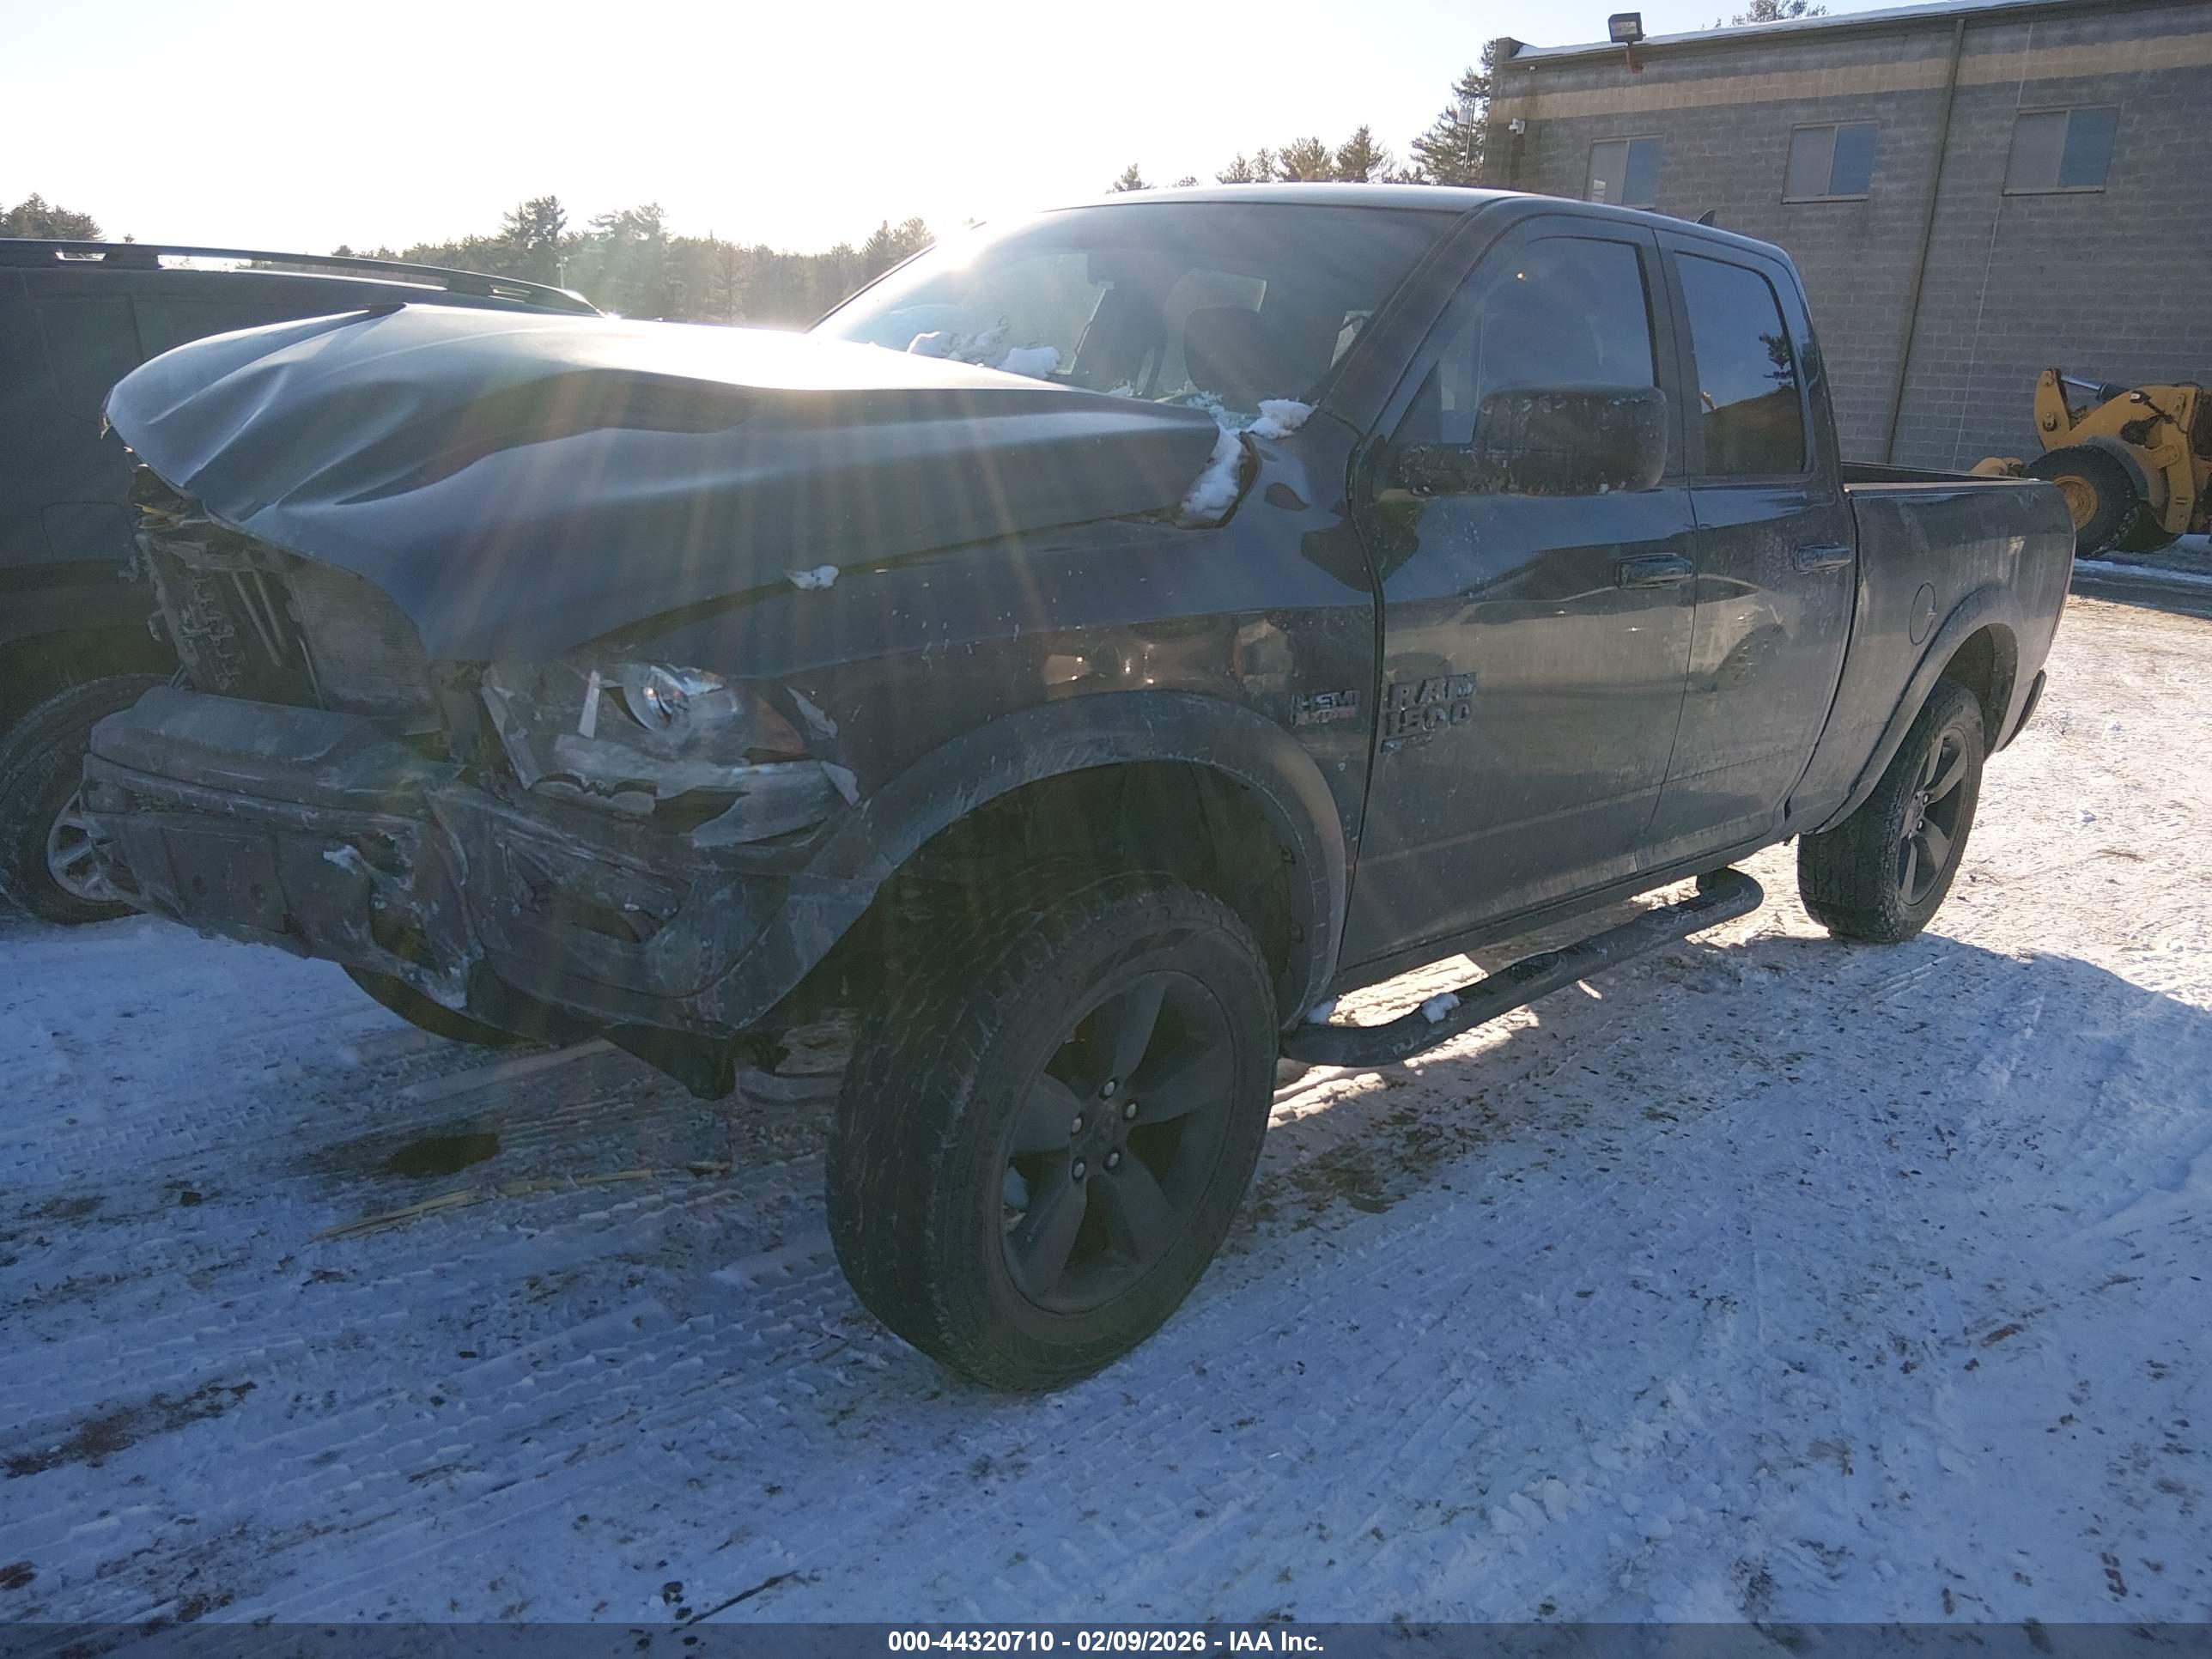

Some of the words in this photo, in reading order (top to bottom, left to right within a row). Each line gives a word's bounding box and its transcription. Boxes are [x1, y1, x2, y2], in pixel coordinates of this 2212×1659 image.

[1291, 689, 1360, 712] HEMI
[1387, 672, 1477, 709] RAM
[1385, 699, 1474, 737] 1500
